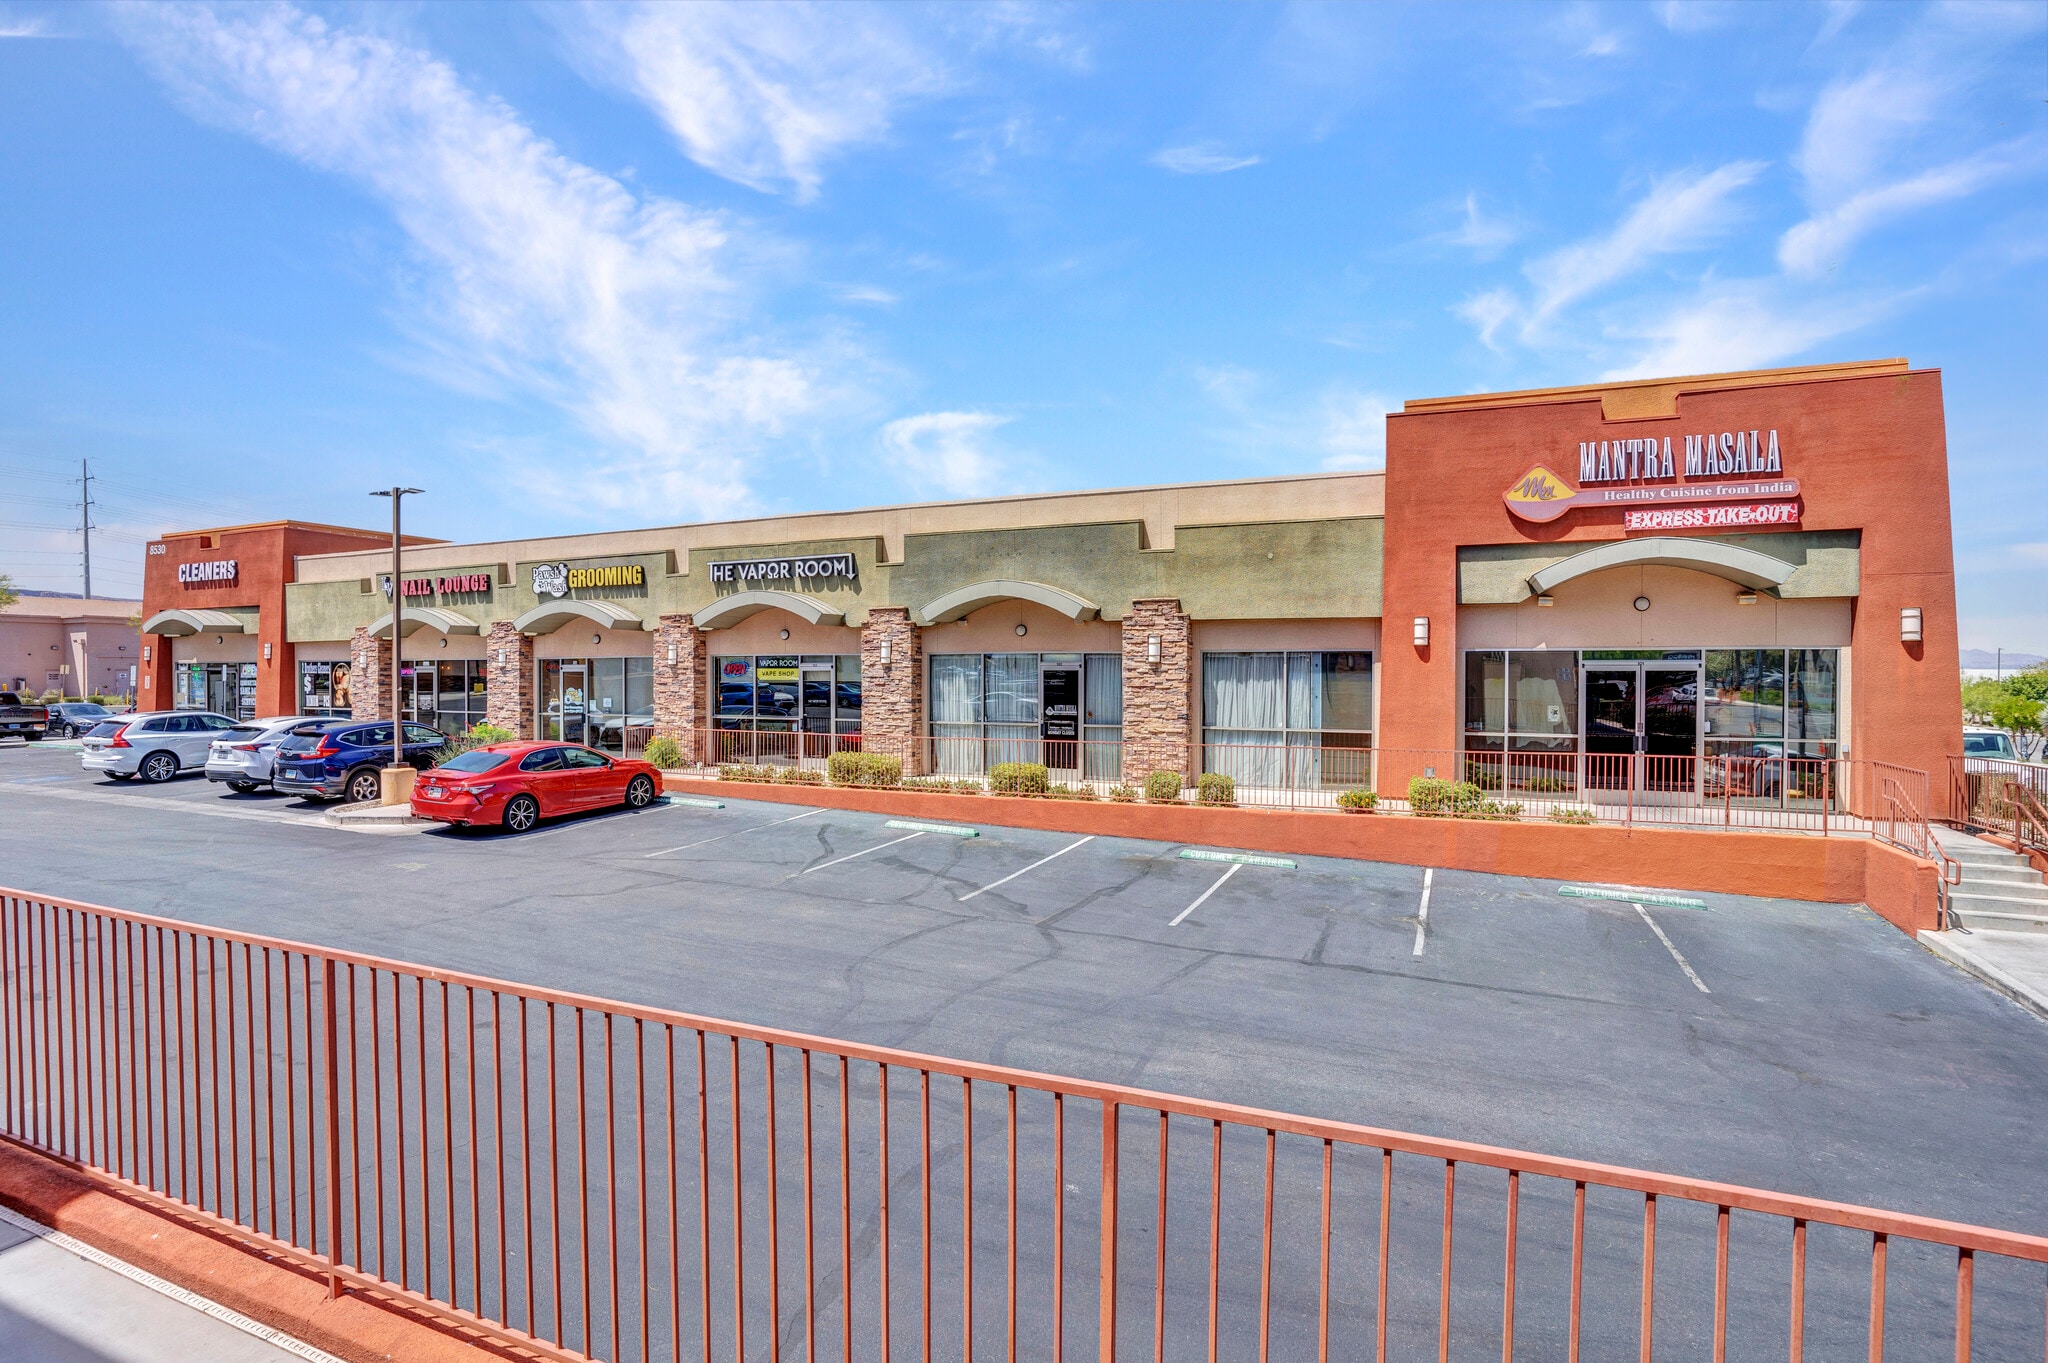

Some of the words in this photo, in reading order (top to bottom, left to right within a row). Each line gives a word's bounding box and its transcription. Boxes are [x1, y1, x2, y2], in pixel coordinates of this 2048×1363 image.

[1579, 437, 1675, 482] MANTRA
[1684, 429, 1782, 477] MASALA
[1604, 489, 1657, 503] Healthy
[1660, 486, 1713, 499] Cuisine
[1716, 485, 1750, 496] from
[1753, 482, 1793, 493] India
[1631, 511, 1703, 528] EXPRESS
[149, 544, 166, 555] 8530
[178, 560, 236, 583] CLEANERS
[532, 568, 560, 580] Pawsh
[795, 558, 846, 577] ROOM
[568, 565, 642, 588] GROOMING
[400, 580, 430, 596] NAIL
[436, 574, 488, 593] LOUNGE
[543, 580, 568, 593] Wash
[723, 663, 746, 675] OPEN
[780, 659, 798, 667] ROOM
[1190, 850, 1233, 861] CUSTOMER
[1241, 856, 1284, 866] PARKING
[1575, 888, 1629, 900] CUSTOMER
[1642, 893, 1697, 904] PARKING
